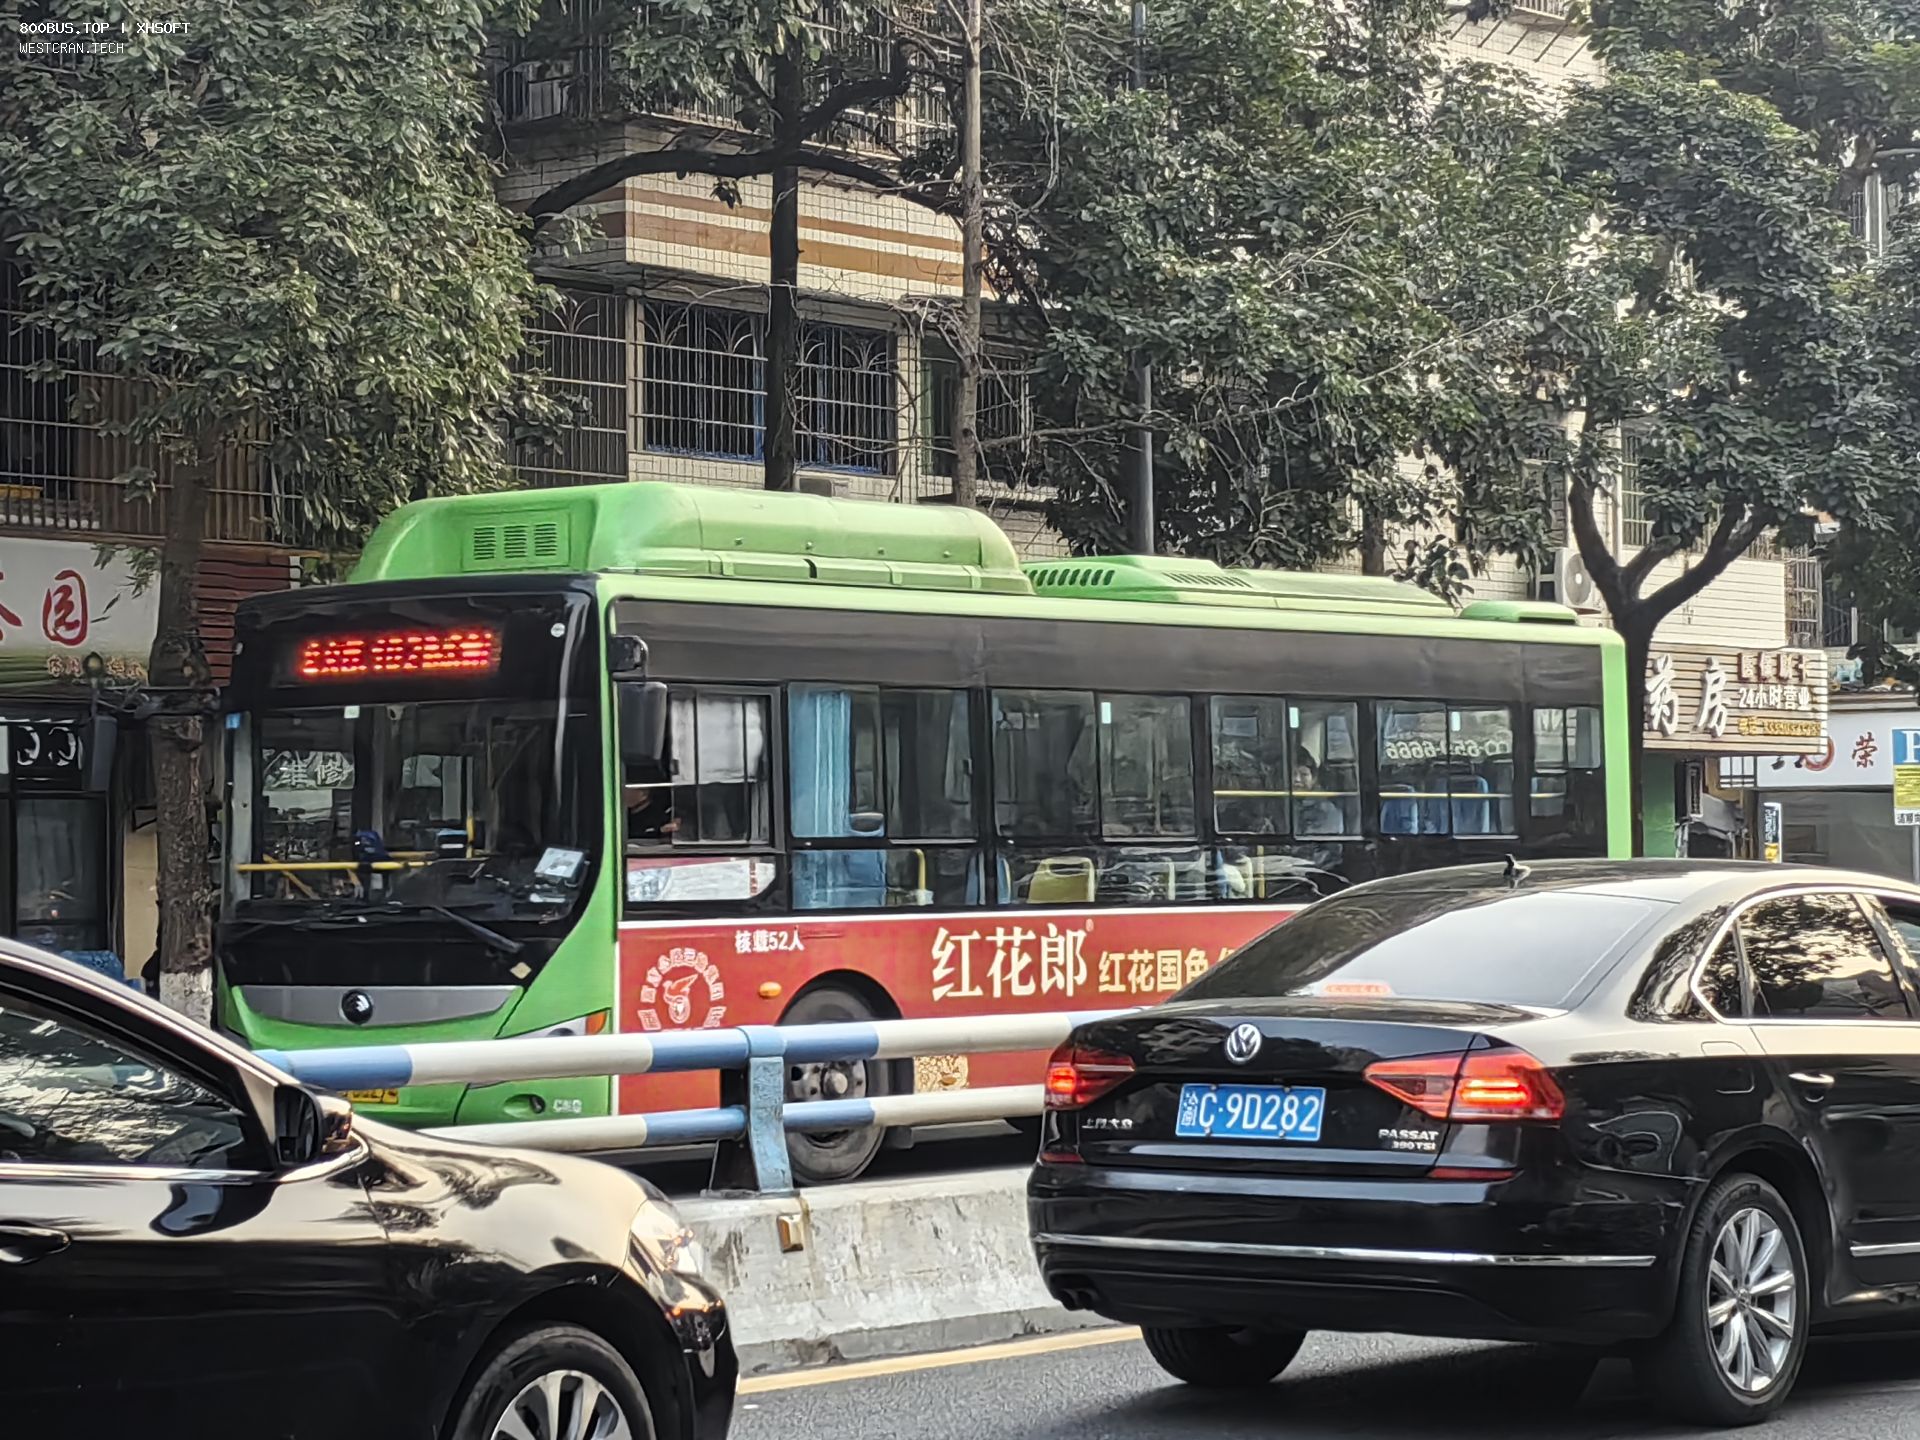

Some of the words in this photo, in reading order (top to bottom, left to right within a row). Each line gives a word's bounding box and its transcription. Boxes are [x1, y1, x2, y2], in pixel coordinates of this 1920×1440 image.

[1738, 684, 1812, 711] 24小时营业
[931, 923, 1088, 1002] 红花郎
[1098, 947, 1209, 994] 红花国色
[1378, 1128, 1440, 1141] PASSAT
